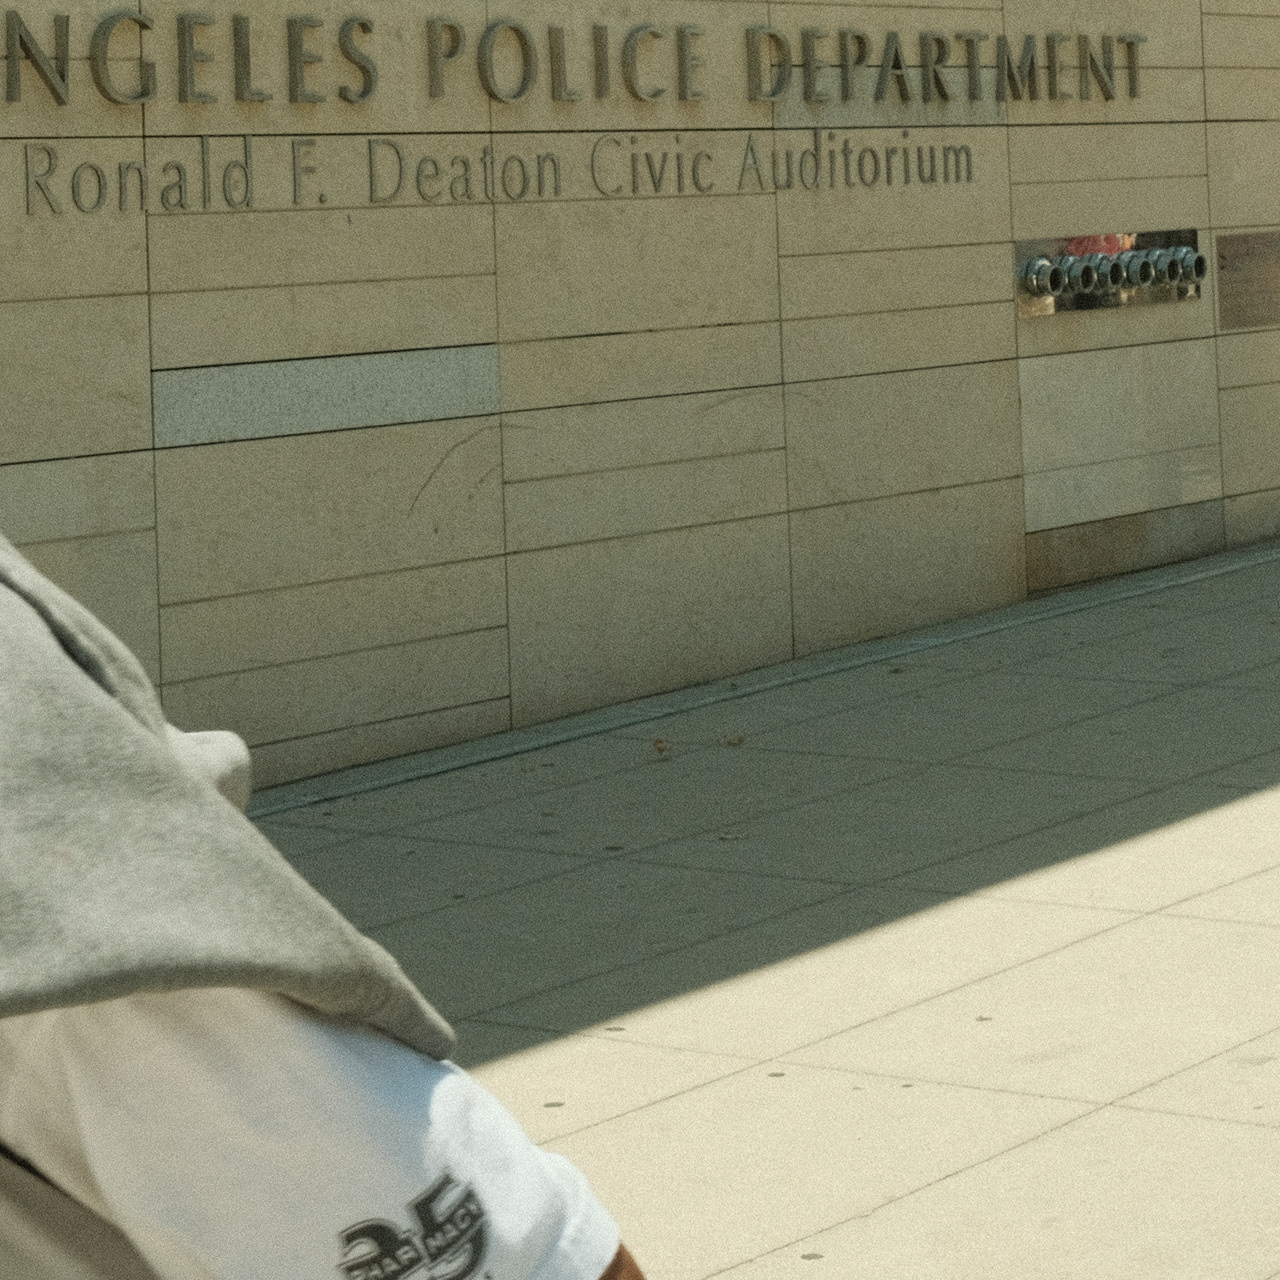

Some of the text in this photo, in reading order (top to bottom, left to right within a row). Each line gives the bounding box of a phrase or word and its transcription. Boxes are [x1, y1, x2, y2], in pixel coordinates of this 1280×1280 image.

[424, 15, 705, 105] POLICE
[744, 22, 1149, 103] DEPARTMENT
[23, 128, 975, 216] Ronald F. Deaton Civic Auditorium
